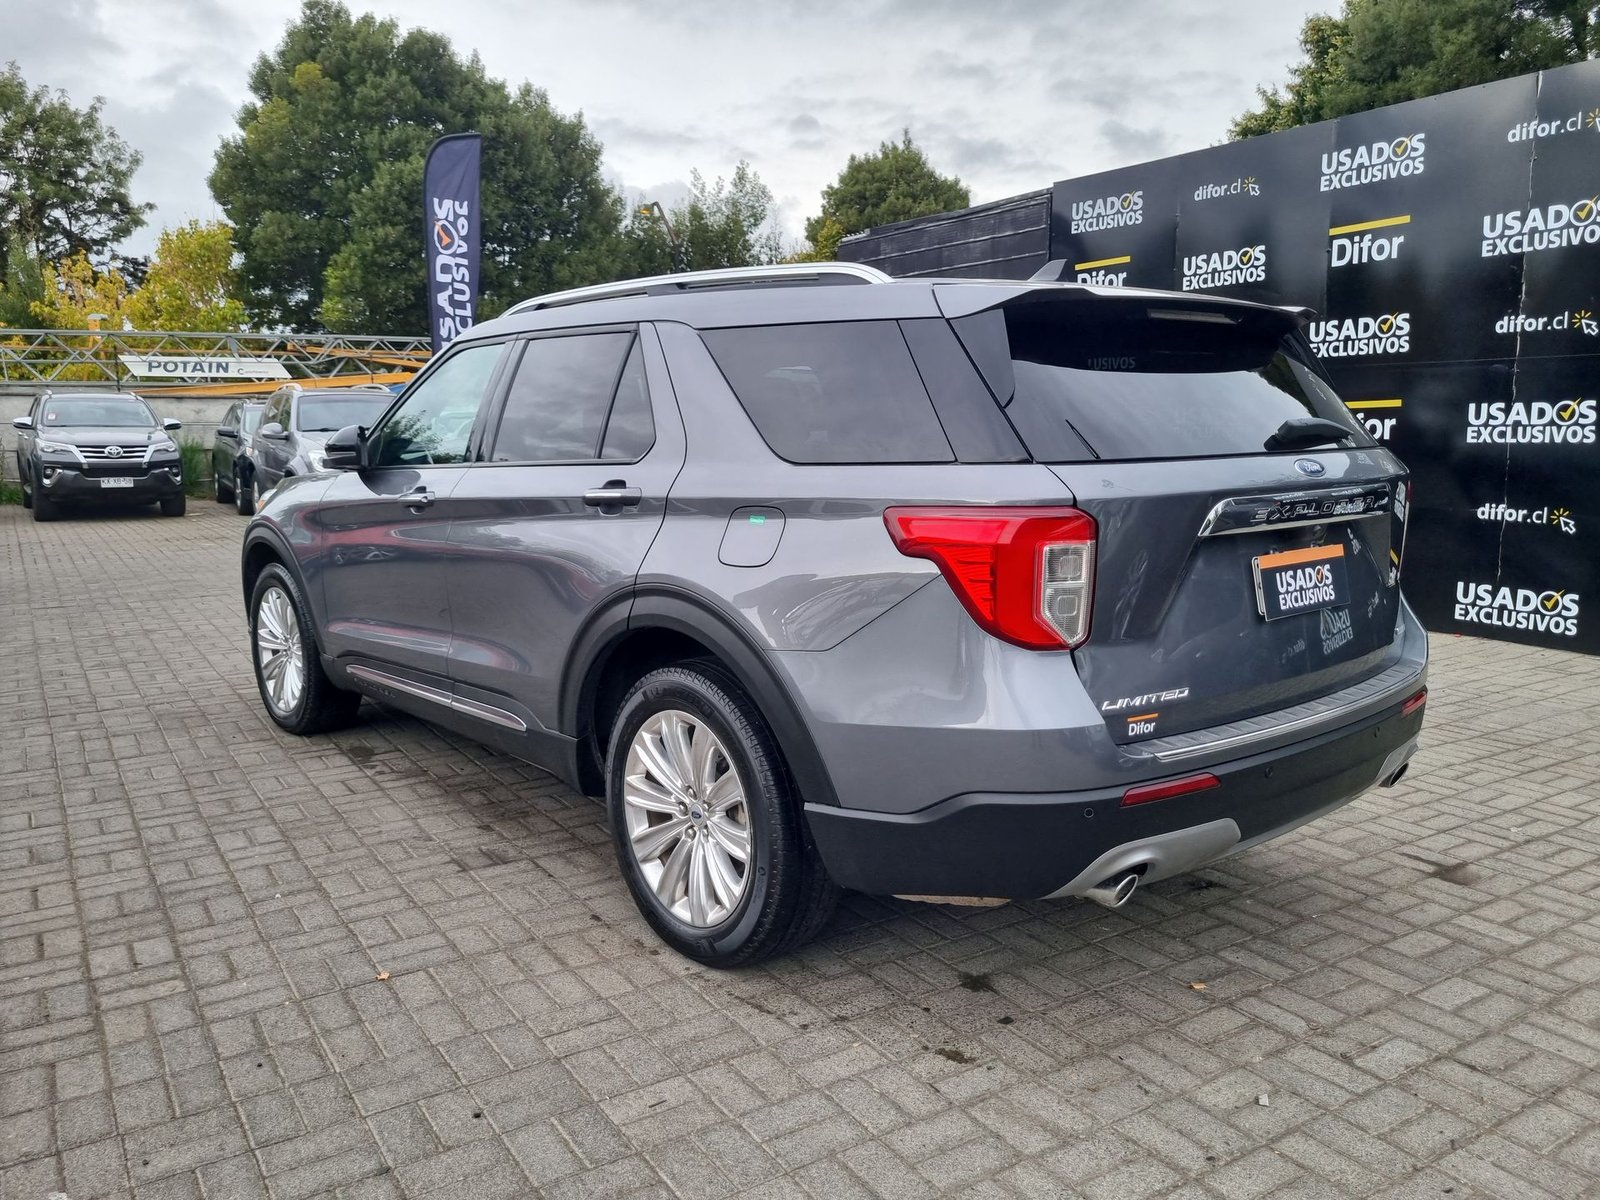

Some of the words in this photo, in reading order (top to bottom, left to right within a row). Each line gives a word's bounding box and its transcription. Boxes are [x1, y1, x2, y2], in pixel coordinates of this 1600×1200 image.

[1507, 112, 1581, 143] difor.cl
[1321, 133, 1425, 174] USADOS
[1194, 178, 1241, 201] difor.cl
[1320, 157, 1424, 192] EXCLUSIVOS
[1071, 190, 1143, 220] USADOS
[1483, 197, 1600, 238] USADO
[1071, 210, 1143, 234] EXCLUSIVOS
[1331, 234, 1404, 267] Difor
[1481, 225, 1600, 257] EXCLUSIVO
[433, 197, 459, 349] SADOS
[453, 200, 473, 334] CLUSIVOS
[1183, 245, 1266, 276] USADOS
[1182, 266, 1266, 291] EXCLUSIVOS
[1309, 312, 1410, 342] USADOS
[1495, 311, 1568, 334] difor.cl
[148, 360, 230, 374] POTAIN
[1468, 398, 1597, 426] USADOS
[1466, 425, 1596, 444] EXCLUSIVOS
[1477, 503, 1547, 524] difor.cl
[1276, 564, 1332, 593] USADOS
[1279, 585, 1335, 610] EXCLUSIVOS
[1456, 581, 1579, 617] USADOS
[1454, 603, 1577, 636] EXCLUSIVOS
[1102, 687, 1189, 710] LIMITED
[1128, 721, 1156, 736] Difor
